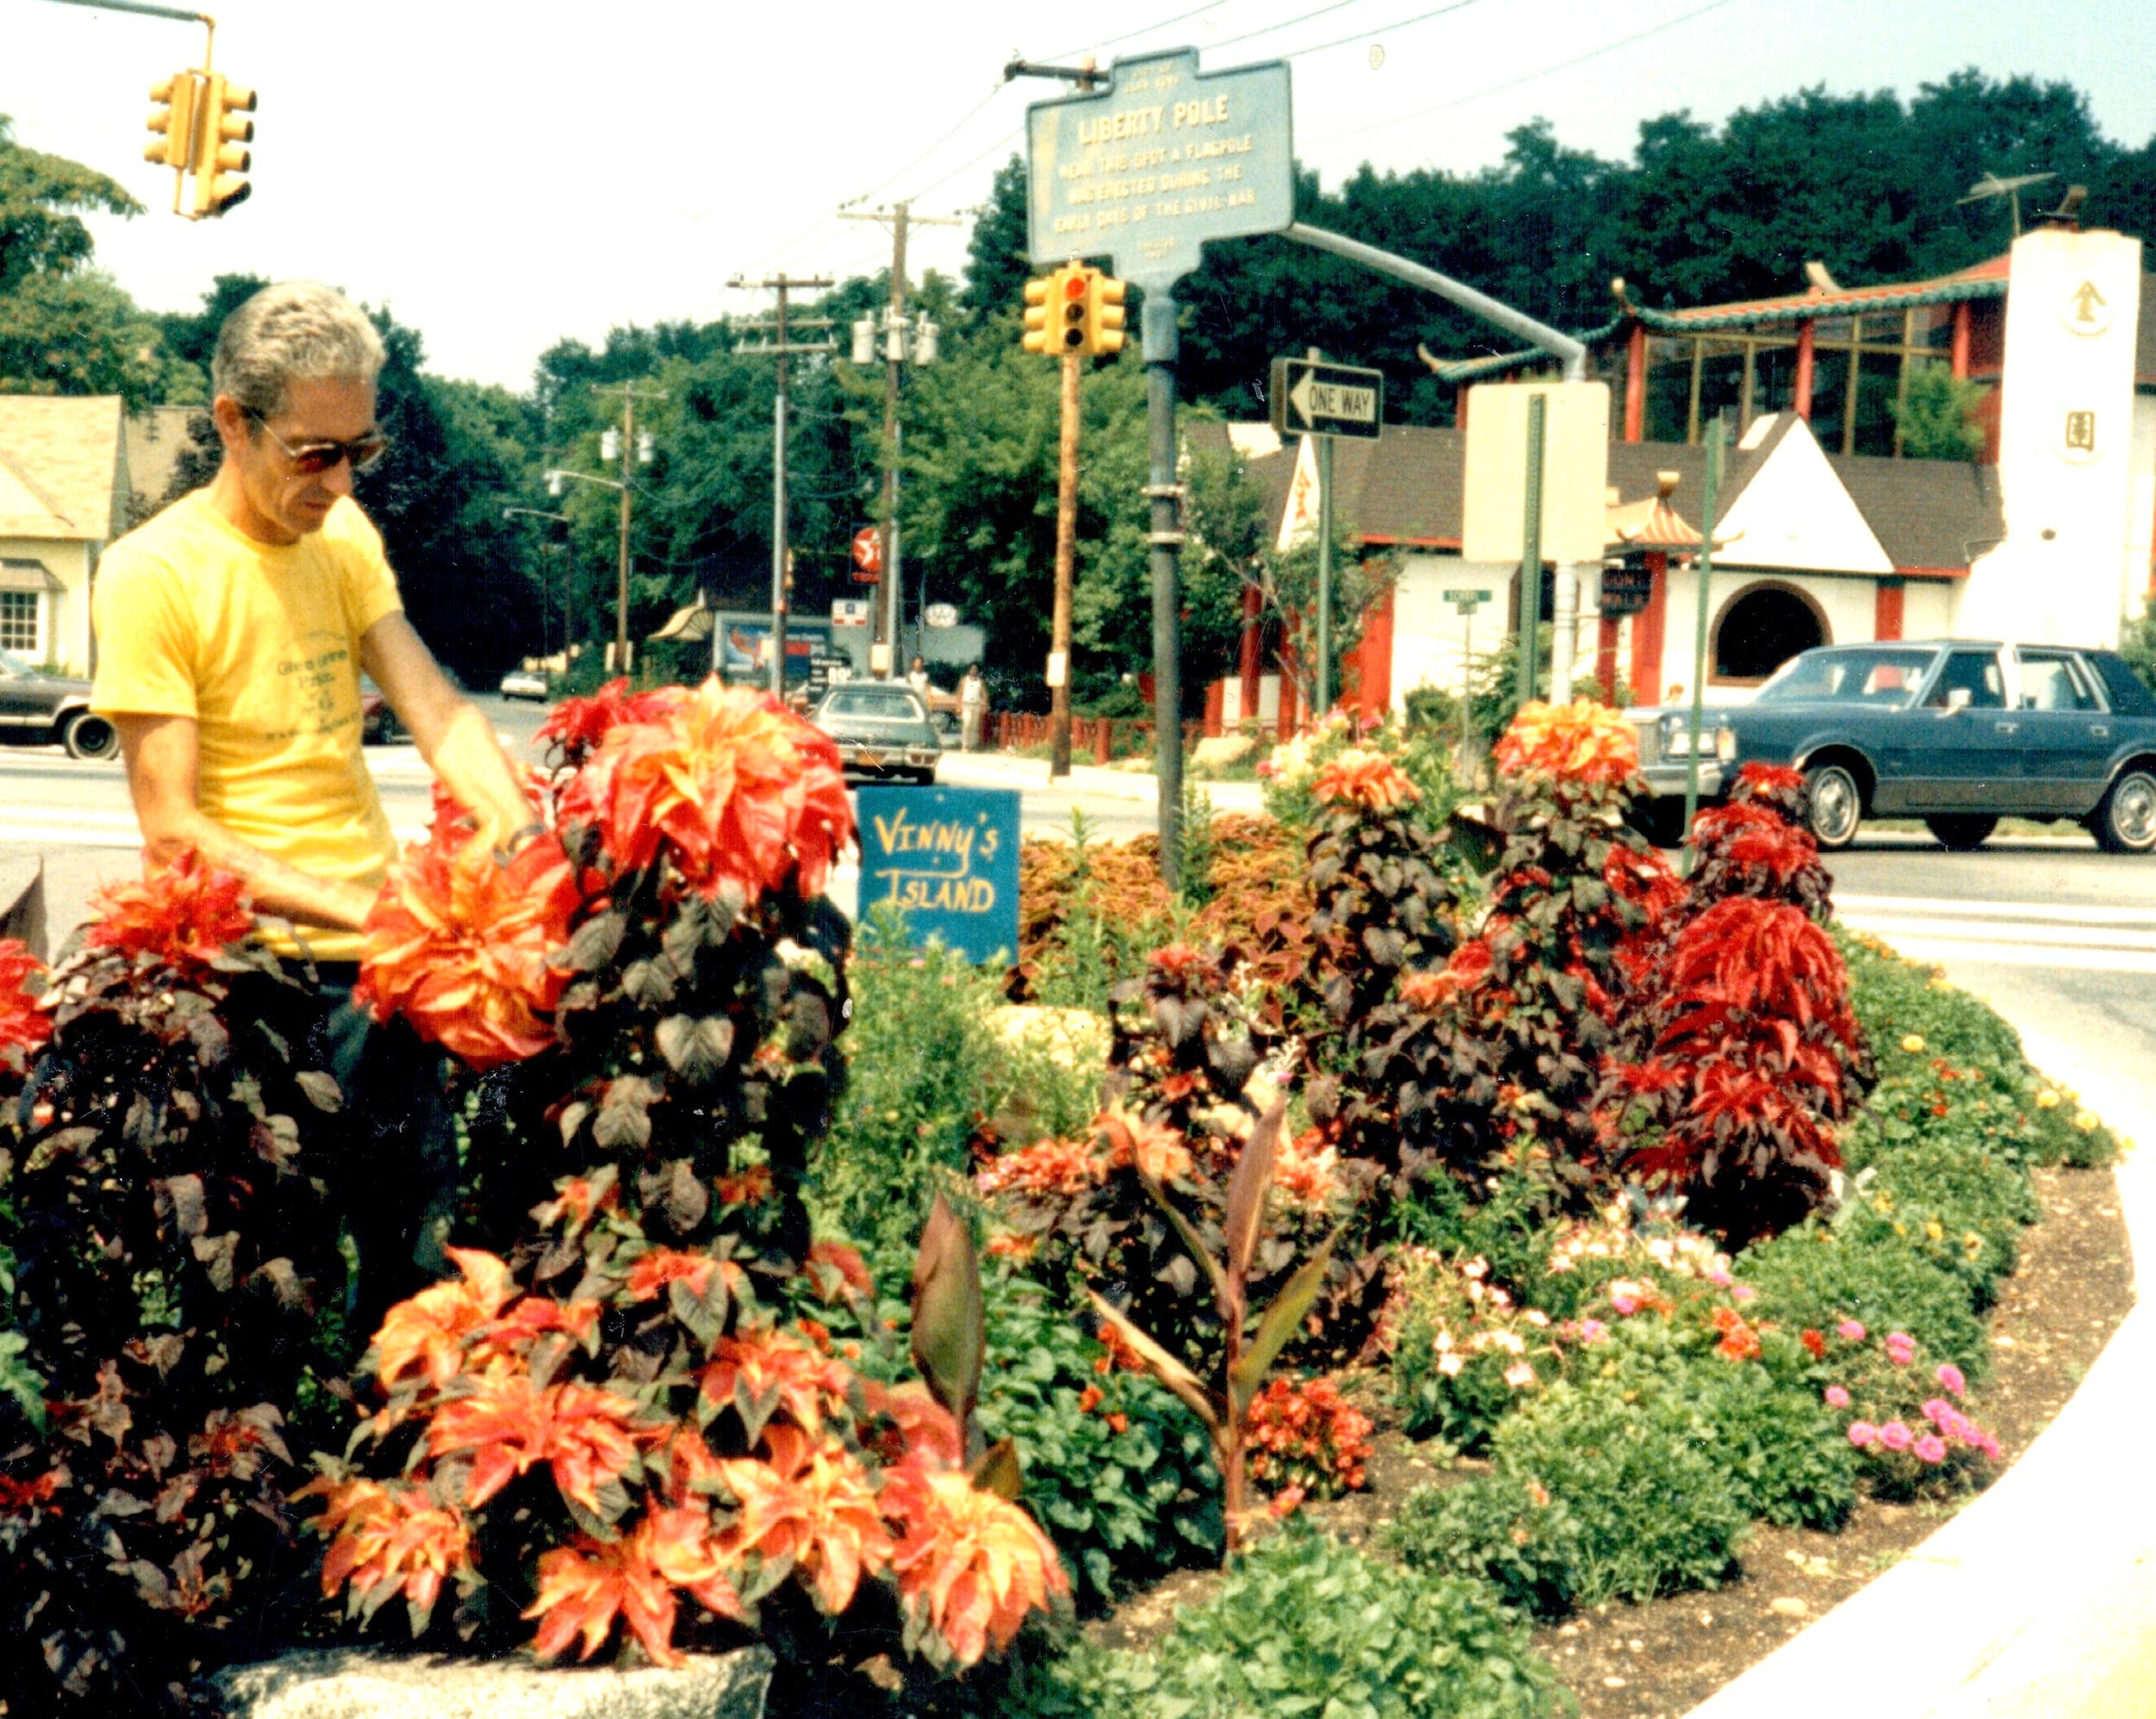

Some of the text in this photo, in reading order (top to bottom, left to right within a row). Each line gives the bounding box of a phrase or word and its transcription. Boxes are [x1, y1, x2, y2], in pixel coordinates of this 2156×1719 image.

[1080, 97, 1228, 144] LIBERTY POLE
[1100, 157, 1127, 172] THIS
[1135, 150, 1166, 168] SPOT
[1173, 149, 1181, 162] A
[1187, 135, 1252, 158] FLAGPOLE
[1099, 178, 1155, 199] ERECTED
[1160, 171, 1210, 191] DURING
[1218, 166, 1242, 181] THE
[1156, 200, 1180, 215] THE
[1228, 191, 1255, 206] WAR
[1309, 386, 1370, 415] ONE WAY
[876, 869, 994, 913] ISLAND
